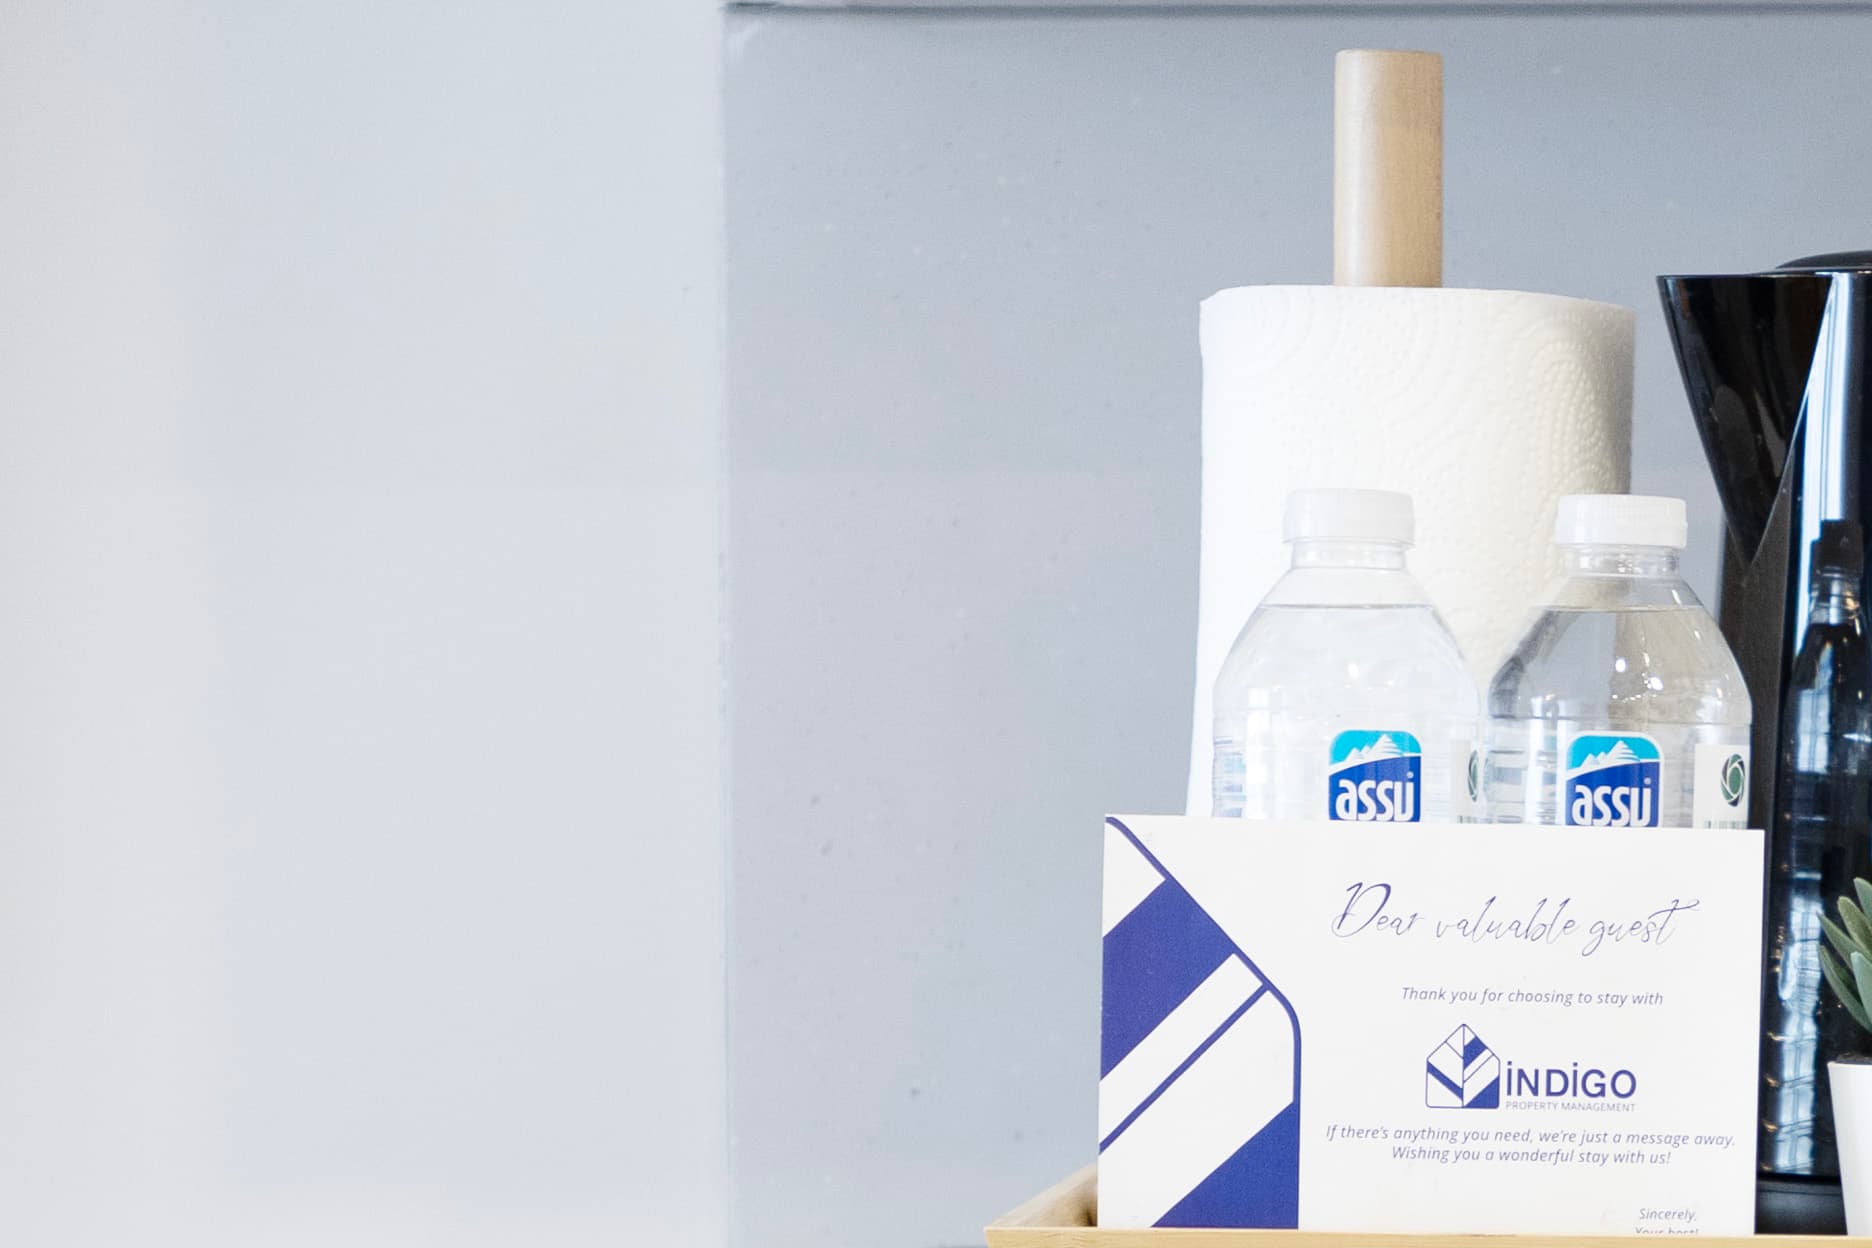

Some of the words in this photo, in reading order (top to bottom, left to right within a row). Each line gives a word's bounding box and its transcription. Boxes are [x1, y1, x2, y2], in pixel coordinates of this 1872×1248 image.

[1331, 882, 1425, 938] Dear
[1436, 896, 1579, 944] valuable
[1581, 899, 1700, 957] guest
[1402, 986, 1446, 1001] Thank
[1449, 990, 1477, 1005] you
[1480, 988, 1503, 1006] for
[1507, 989, 1573, 1008] choosing
[1577, 992, 1593, 1005] to
[1596, 992, 1628, 1008] stay
[1631, 992, 1664, 1006] with
[1505, 1101, 1558, 1111] PROPERTY
[1561, 1102, 1636, 1113] MANAGEMENT
[1326, 1125, 1339, 1142] If
[1393, 1127, 1459, 1144] anything
[1462, 1130, 1490, 1145] you
[1494, 1128, 1534, 1144] need,
[1579, 1131, 1608, 1147] just
[1612, 1133, 1622, 1144] a
[1626, 1134, 1690, 1149] message
[1694, 1134, 1736, 1149] away.
[1392, 1146, 1450, 1164] Wishing
[1453, 1149, 1480, 1165] you
[1485, 1151, 1495, 1162] a
[1499, 1149, 1575, 1166] wonderful
[1578, 1151, 1609, 1167] stay
[1613, 1152, 1645, 1165] with
[1649, 1152, 1671, 1165] us!
